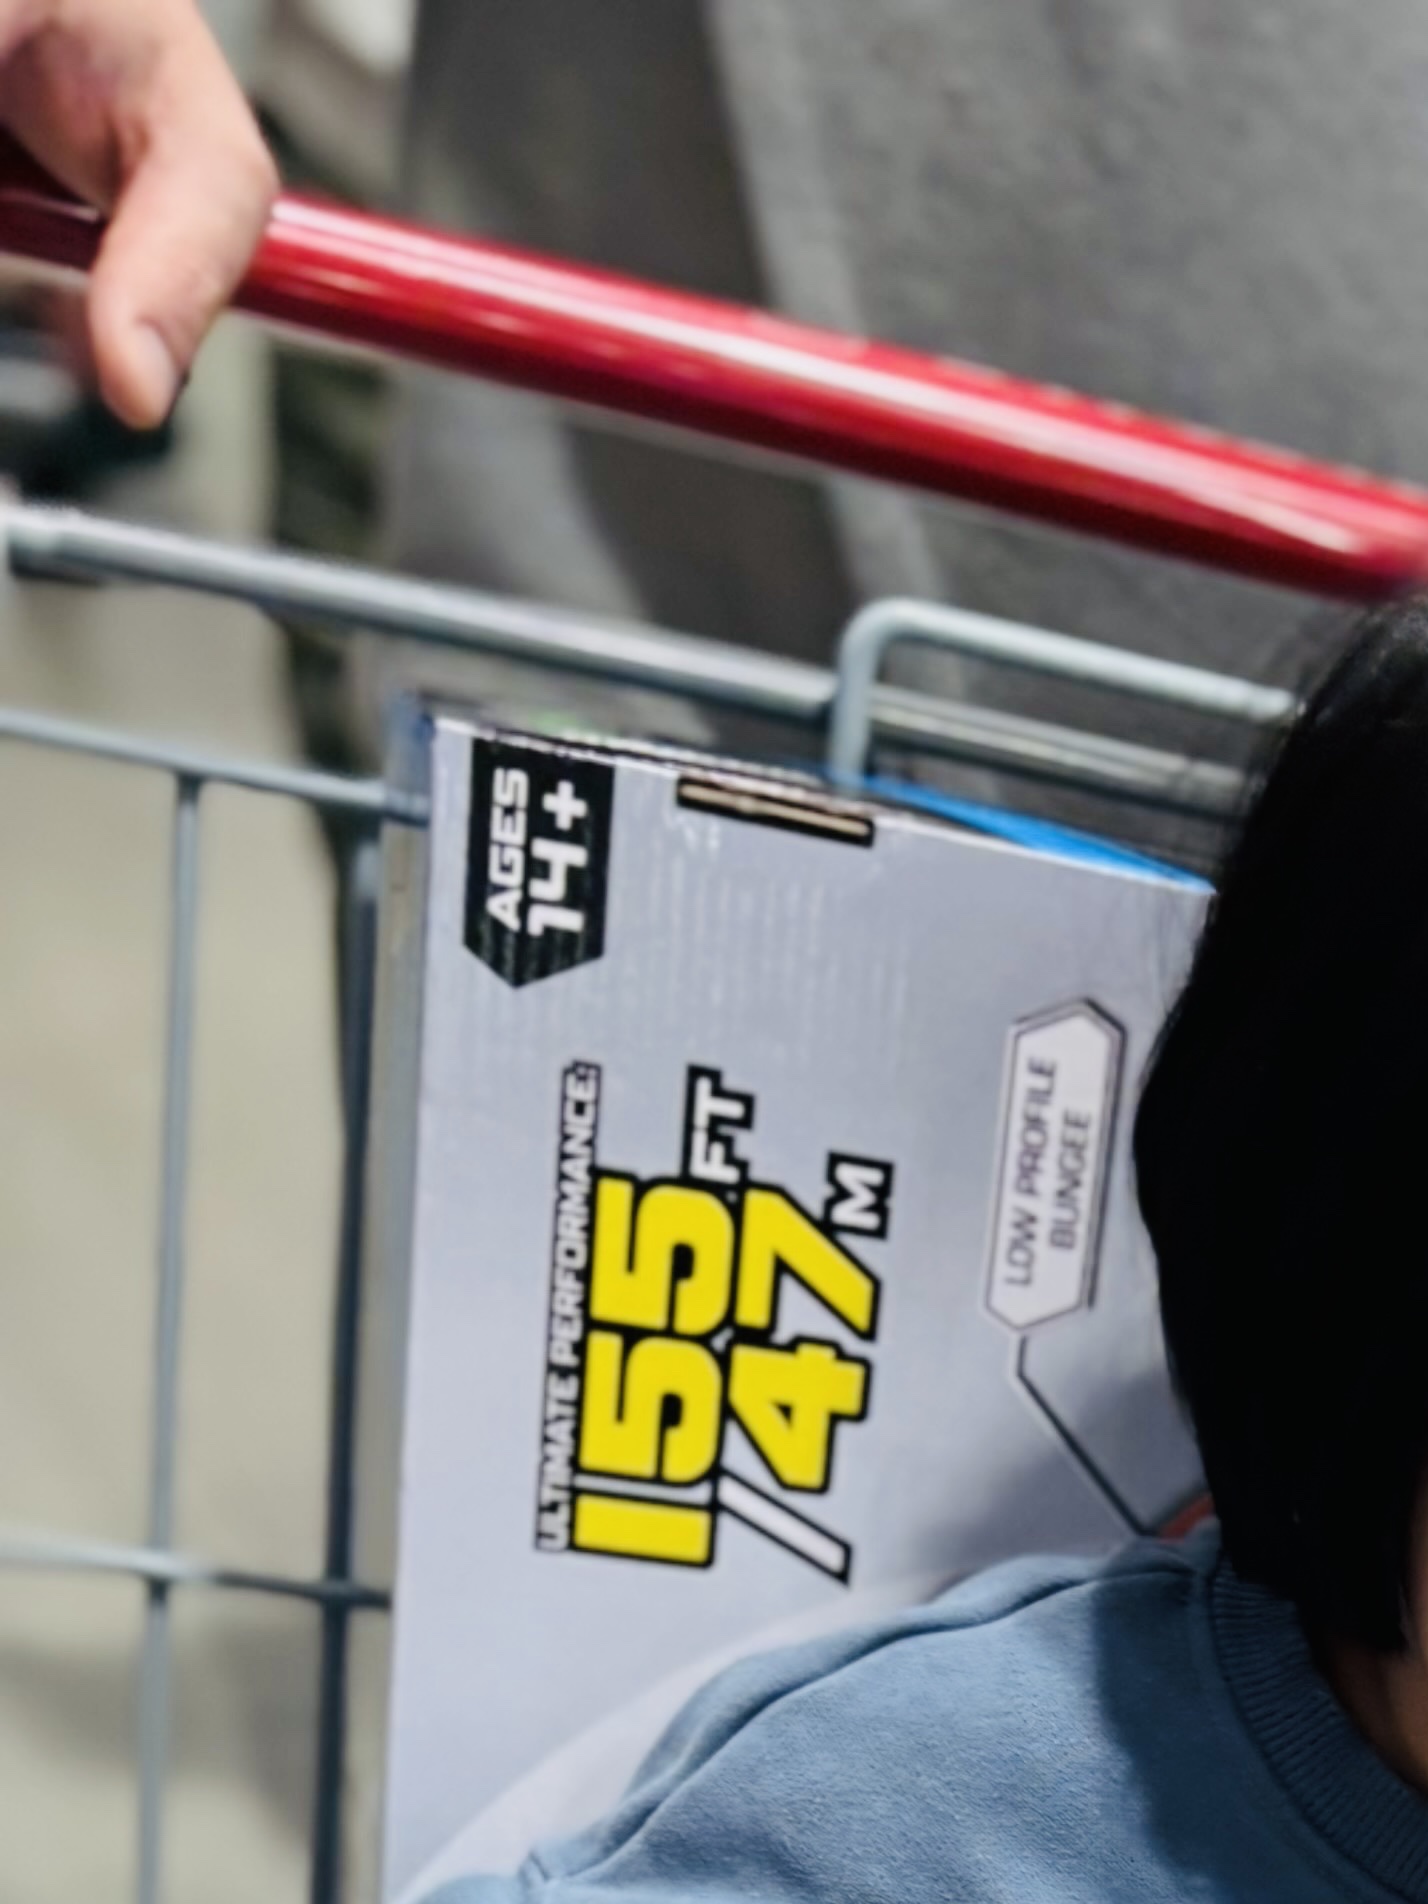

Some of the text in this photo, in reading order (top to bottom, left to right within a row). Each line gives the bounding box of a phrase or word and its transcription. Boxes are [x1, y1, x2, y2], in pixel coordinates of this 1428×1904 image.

[485, 768, 530, 932] AGES
[528, 783, 588, 936] 14+
[1002, 1055, 1059, 1288] LOW PROFILE
[1047, 1106, 1092, 1252] BUNGEE
[536, 1060, 603, 1551] ULTIMATE PERFORMANCE:
